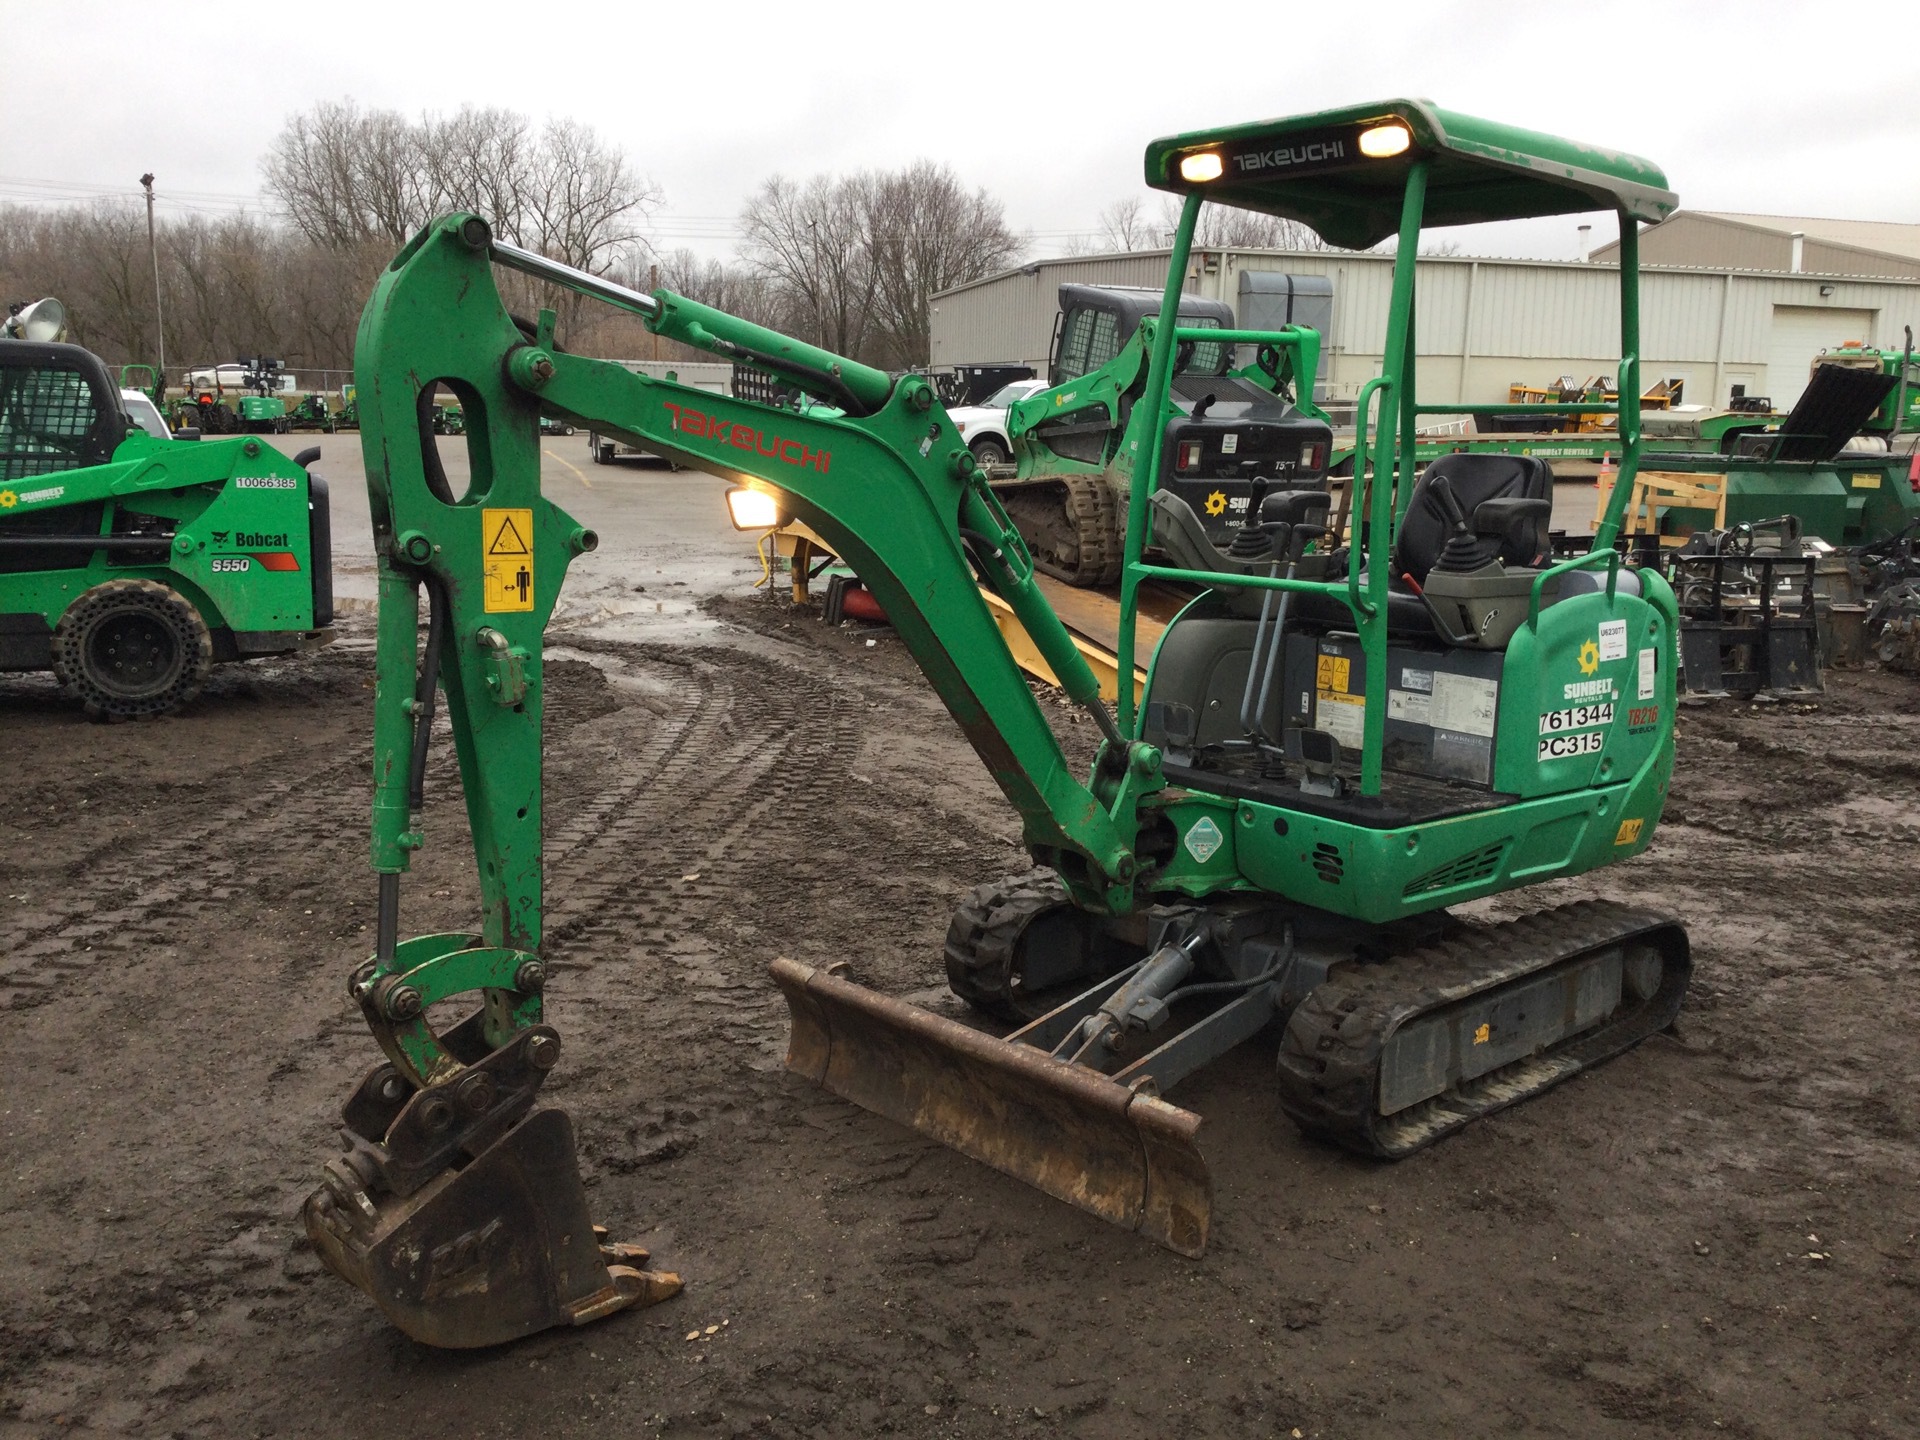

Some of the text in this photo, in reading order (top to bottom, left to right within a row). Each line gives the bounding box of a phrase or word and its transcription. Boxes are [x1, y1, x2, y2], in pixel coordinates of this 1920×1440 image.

[1563, 448, 1594, 456] RENTALS
[238, 477, 296, 488] 10066385
[236, 532, 288, 547] Bobcat
[212, 559, 250, 572] S550
[1600, 626, 1625, 637] U623077
[1564, 678, 1613, 700] SUNBELT
[1575, 694, 1603, 704] RENTALS
[1540, 703, 1612, 732] 761344
[1628, 705, 1658, 726] TB216
[1539, 732, 1602, 760] PC315
